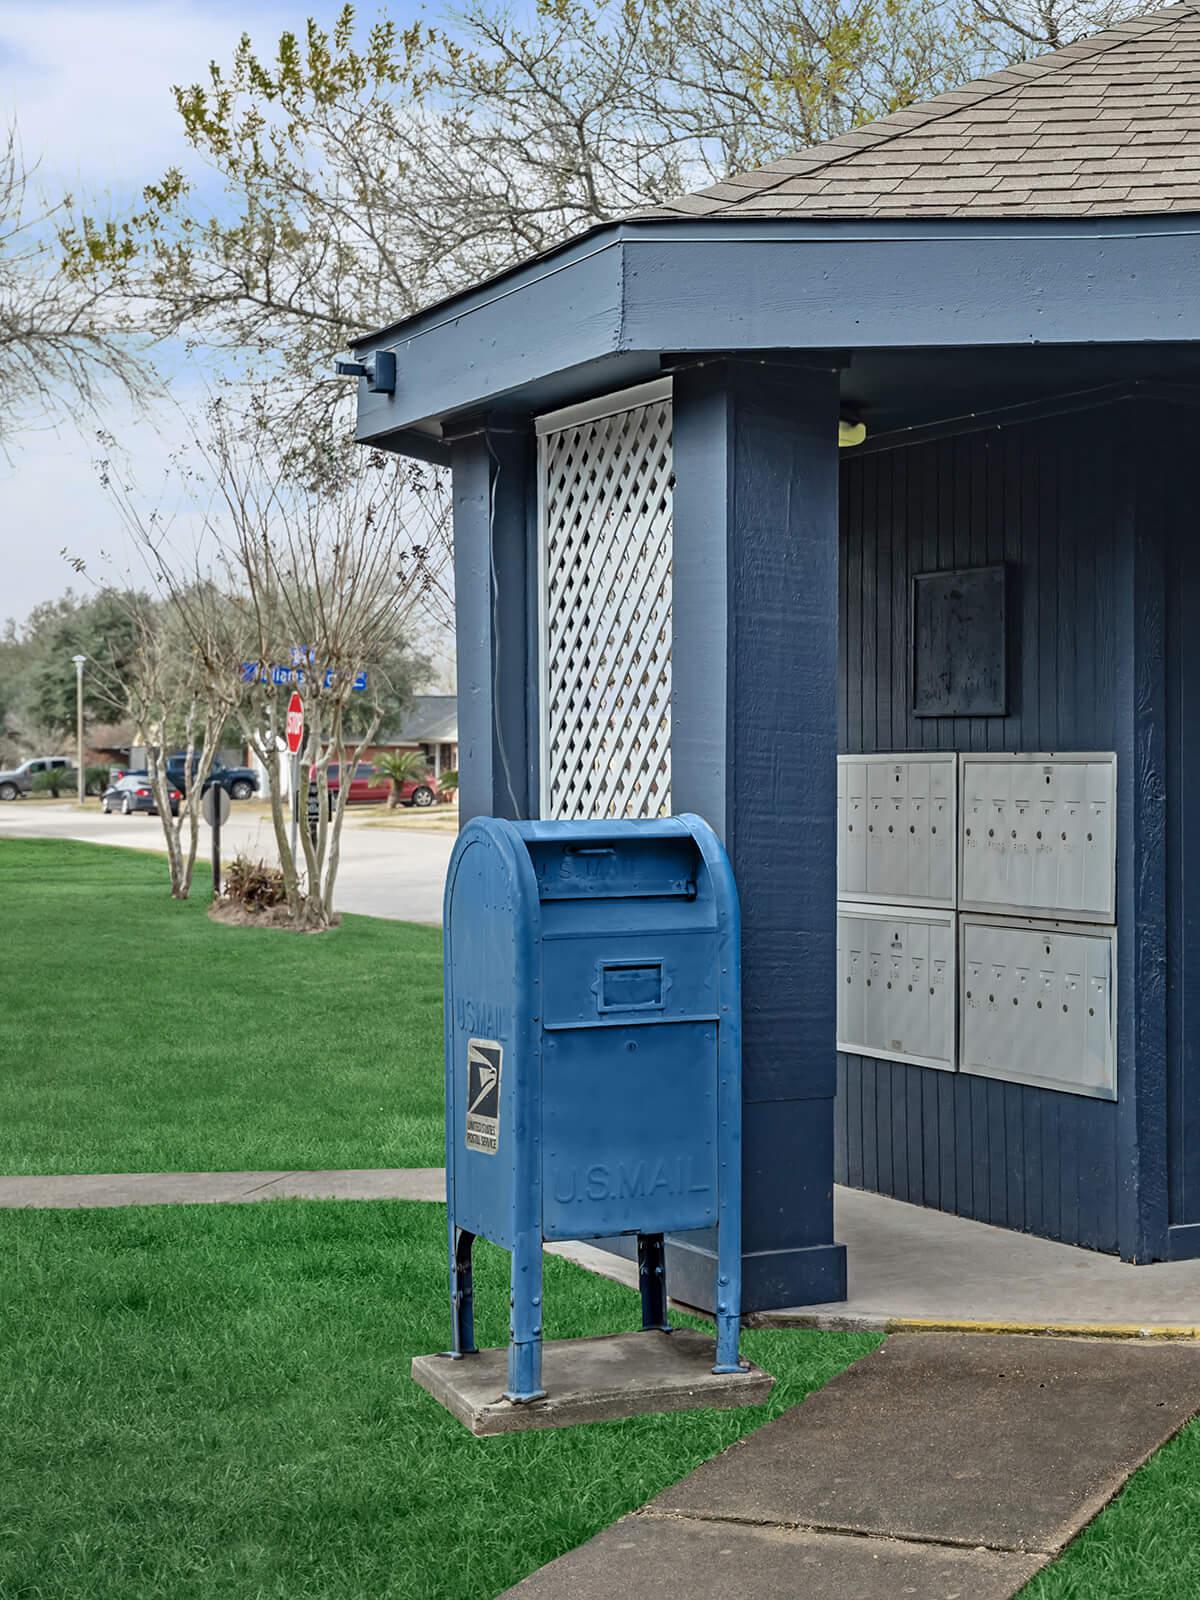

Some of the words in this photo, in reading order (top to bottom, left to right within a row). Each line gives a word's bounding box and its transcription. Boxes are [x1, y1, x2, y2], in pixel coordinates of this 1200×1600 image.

[287, 711, 304, 735] STOP
[467, 1120, 481, 1132] UNITED
[481, 1123, 496, 1135] STATES
[467, 1132, 481, 1145] POSTAL
[481, 1135, 497, 1149] SERVICE
